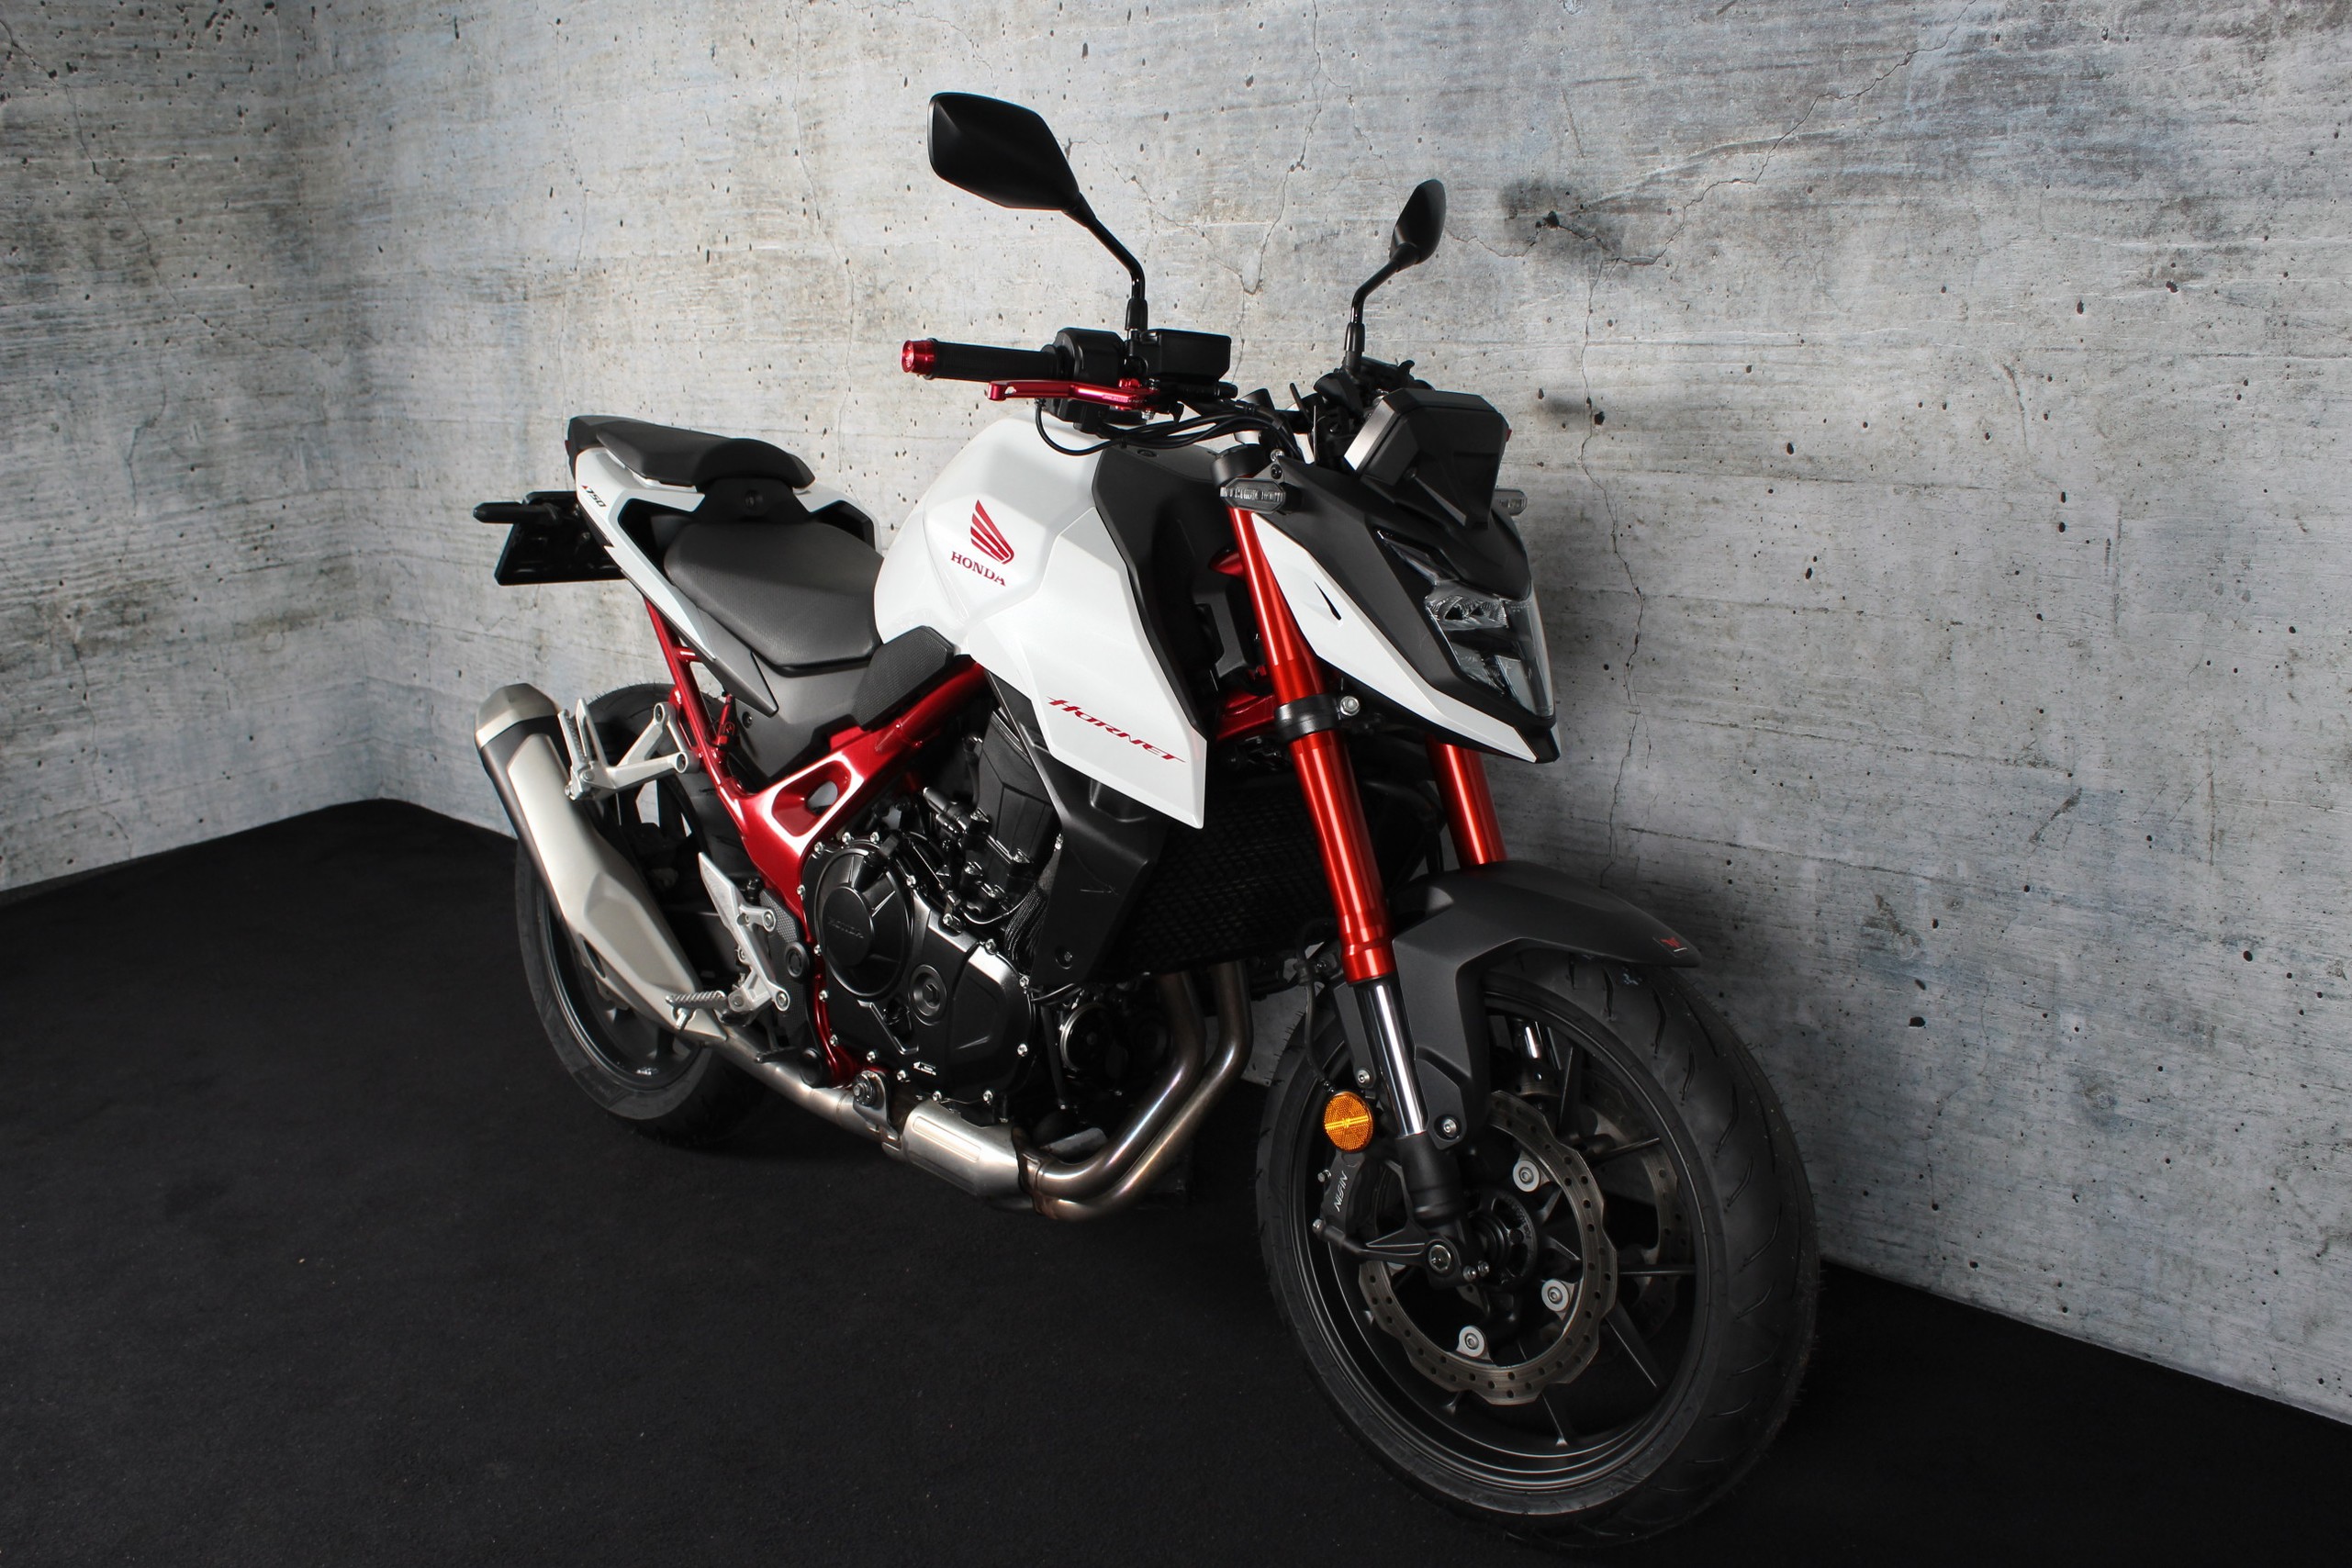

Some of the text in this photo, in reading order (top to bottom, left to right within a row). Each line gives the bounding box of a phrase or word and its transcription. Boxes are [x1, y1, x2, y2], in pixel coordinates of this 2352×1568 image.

[586, 487, 607, 507] 750
[950, 551, 1006, 588] HONDA
[1047, 696, 1186, 763] HORNET
